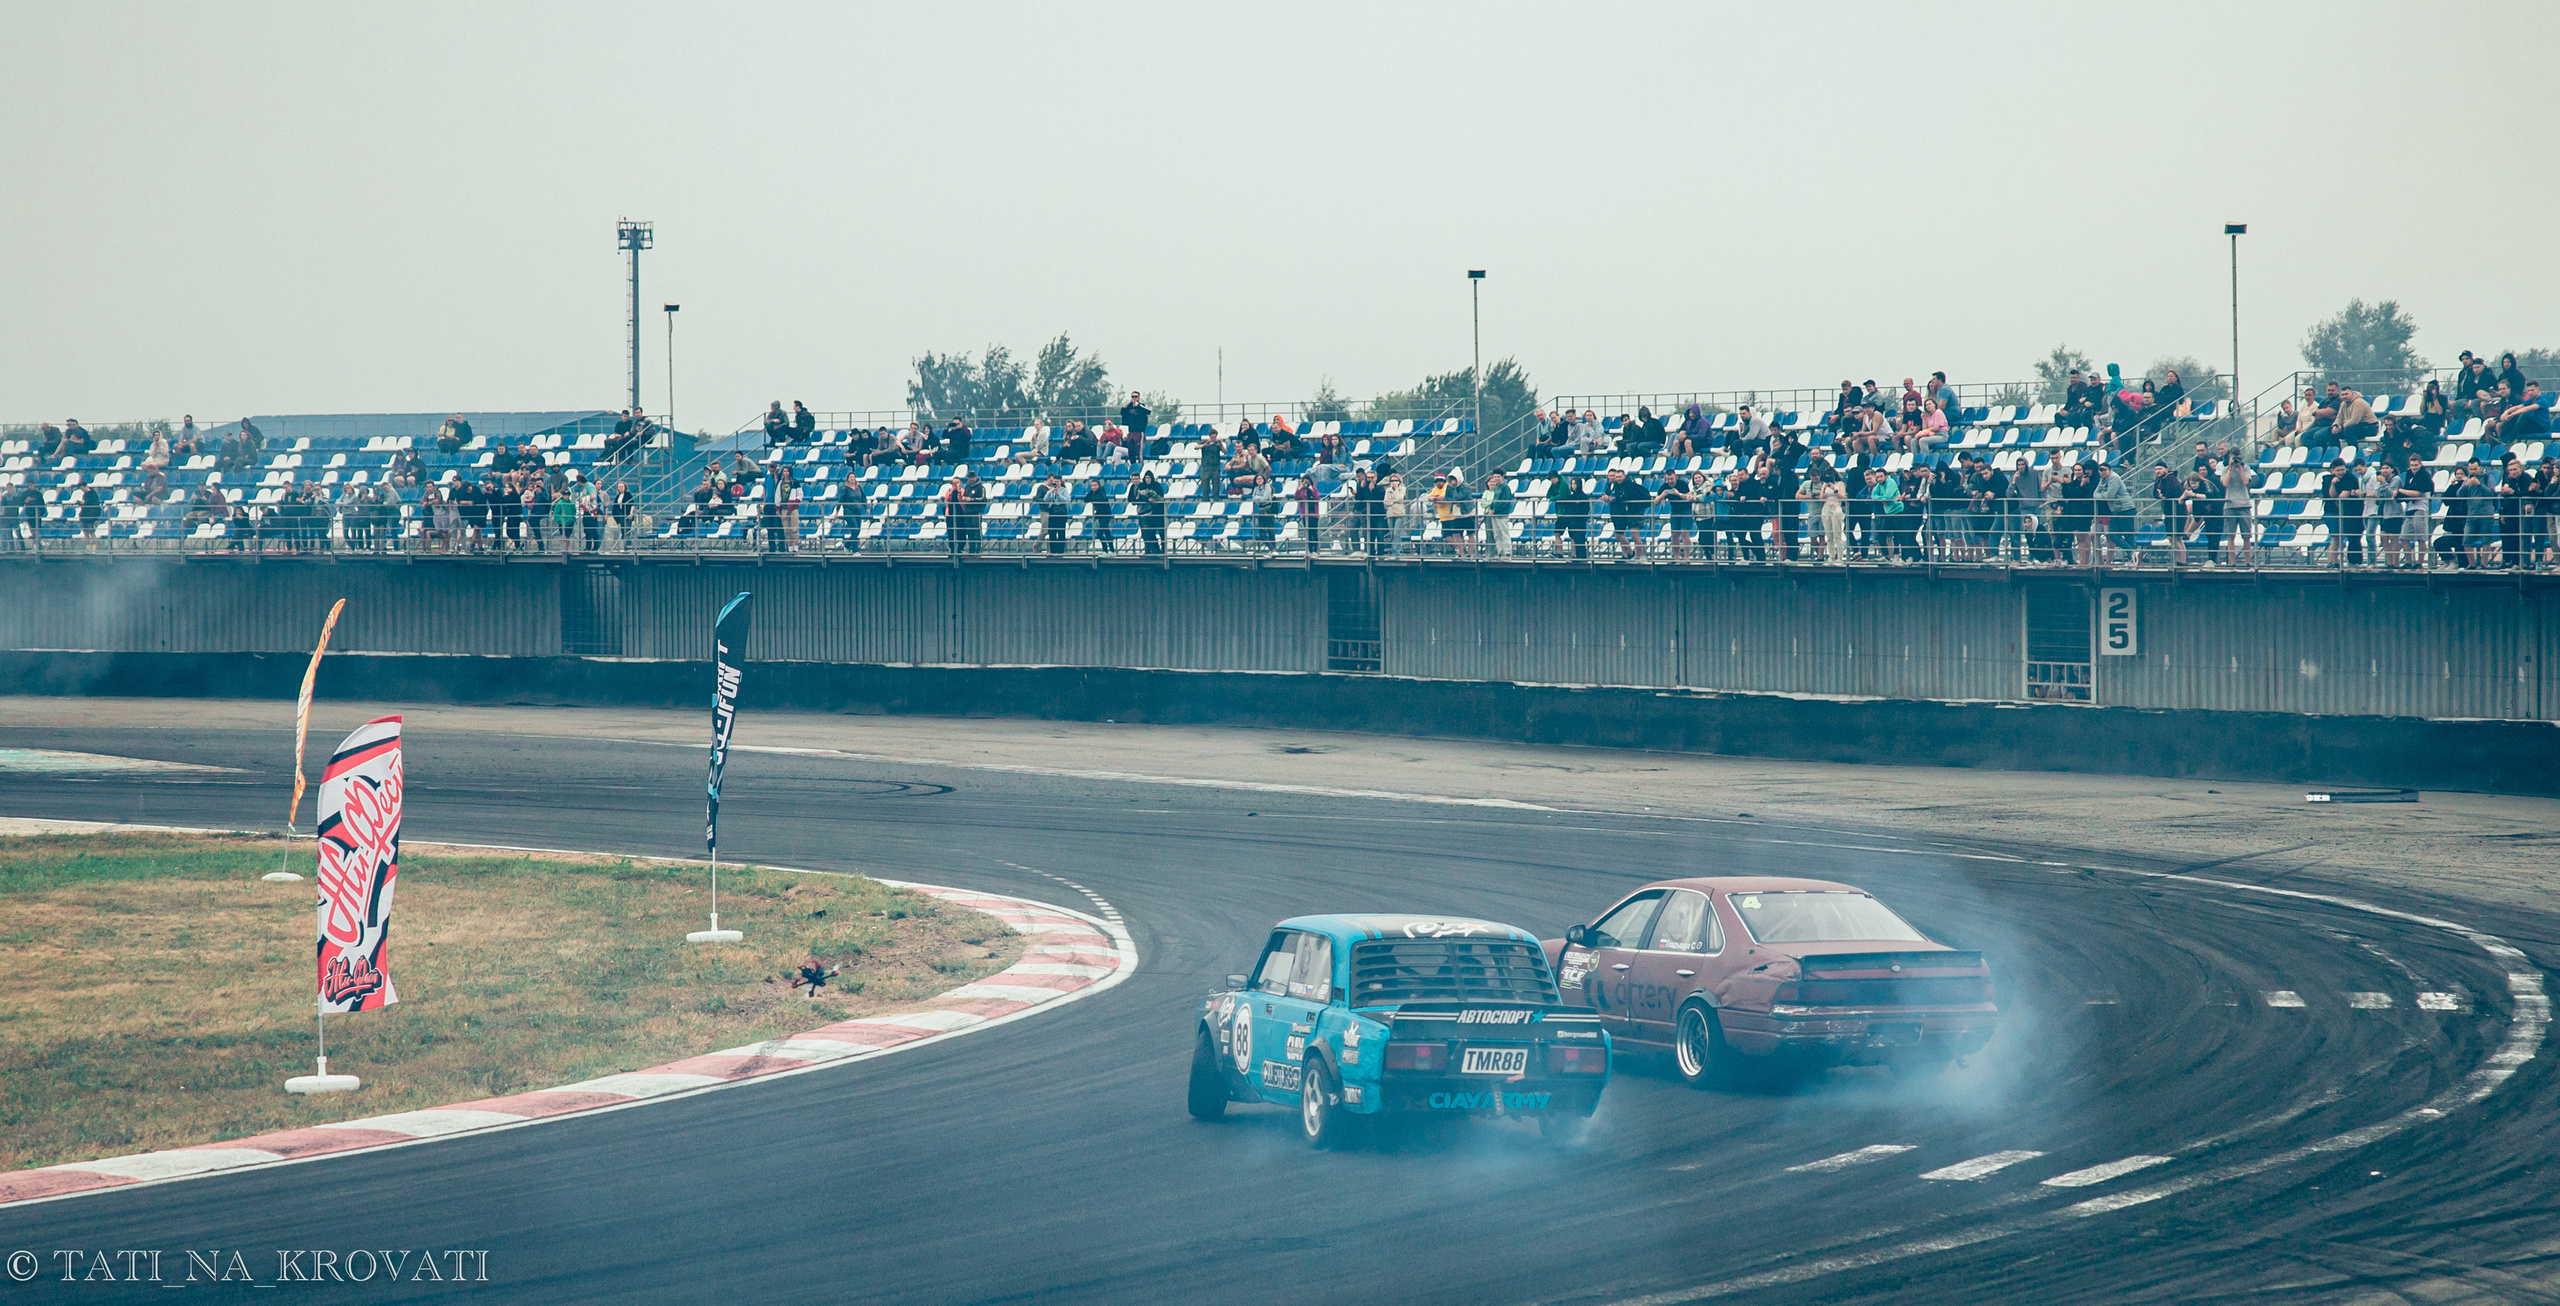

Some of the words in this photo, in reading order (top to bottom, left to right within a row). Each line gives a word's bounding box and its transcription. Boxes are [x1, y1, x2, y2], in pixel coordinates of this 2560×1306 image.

[2109, 592, 2129, 650] 25
[1456, 1010, 1533, 1024] АВТОСПОРТ
[1236, 1022, 1249, 1057] 88
[1467, 1050, 1525, 1071] TMR88
